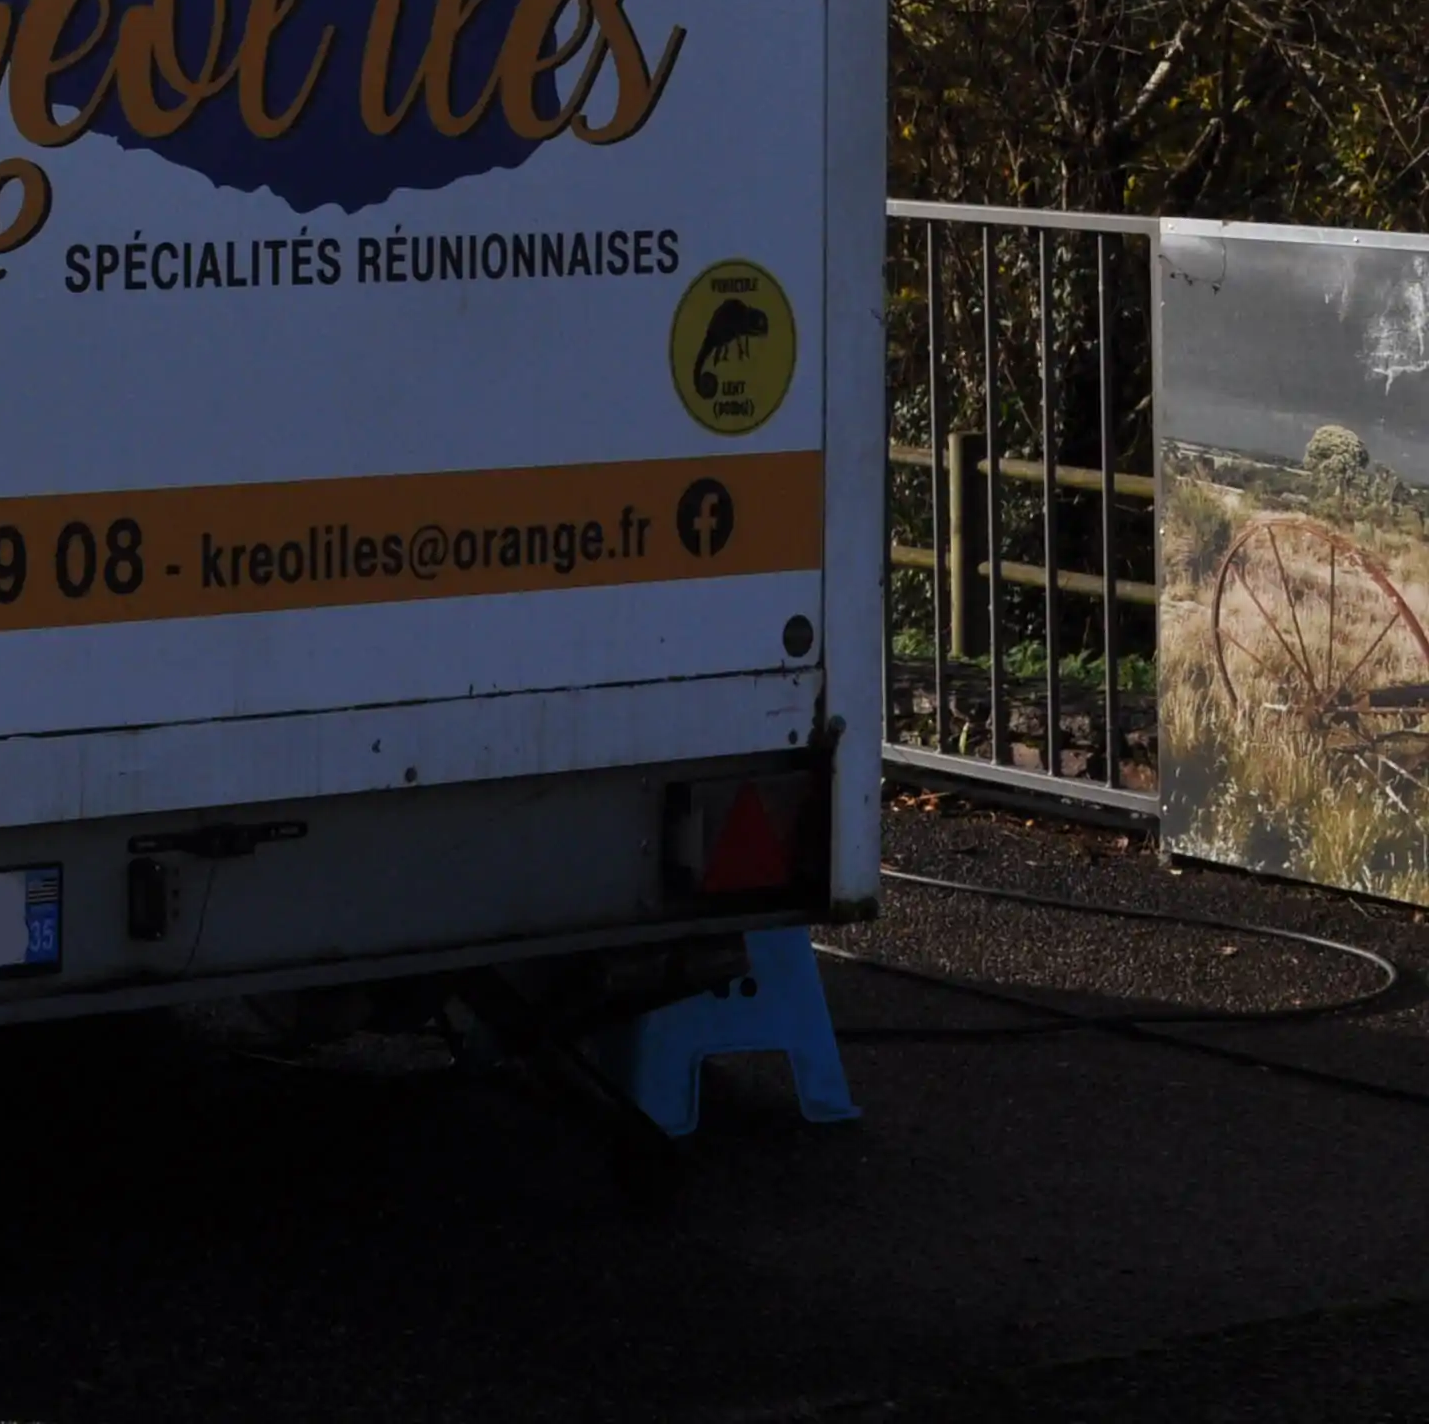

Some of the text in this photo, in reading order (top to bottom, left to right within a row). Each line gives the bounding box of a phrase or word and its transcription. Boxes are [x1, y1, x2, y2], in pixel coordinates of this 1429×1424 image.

[65, 224, 680, 294] SPÉCIALITÉS RÉUNIONNAISES
[55, 518, 143, 598] 08
[201, 505, 651, 589] kreoliles@orange.fr
[28, 920, 55, 953] 35
